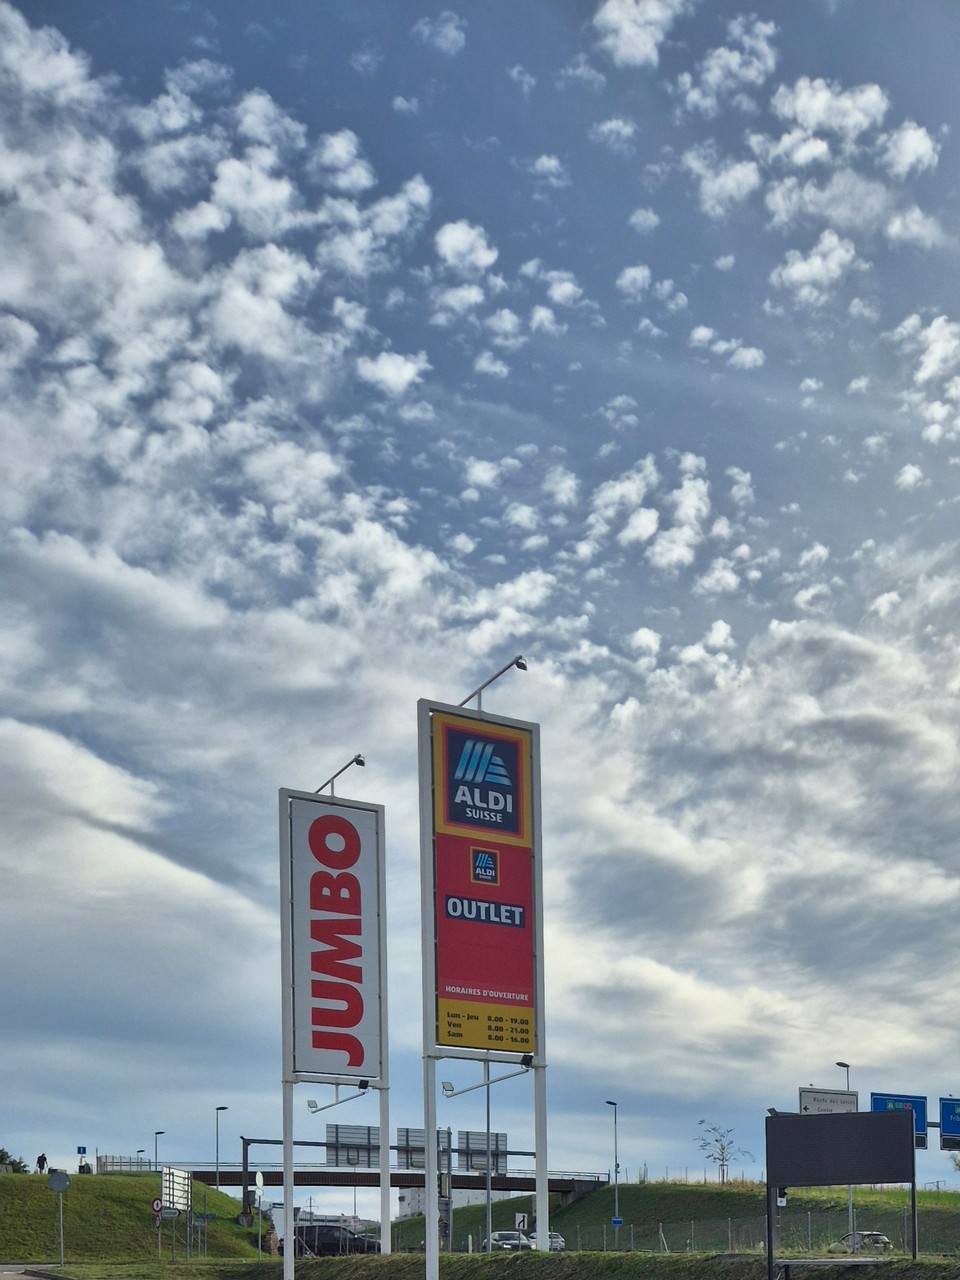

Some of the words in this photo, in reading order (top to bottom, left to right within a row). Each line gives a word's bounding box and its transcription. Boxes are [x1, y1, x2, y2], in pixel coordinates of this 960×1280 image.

[454, 785, 513, 812] ALDI
[466, 807, 503, 823] SUISSE
[475, 867, 495, 878] ALDI
[447, 897, 524, 925] OUTLET
[308, 814, 365, 1067] JUMBO
[445, 985, 481, 996] HORAIRES
[482, 990, 529, 1001] D'OUVERTURE
[510, 1017, 529, 1025] 19.00
[510, 1036, 529, 1044] 16.00
